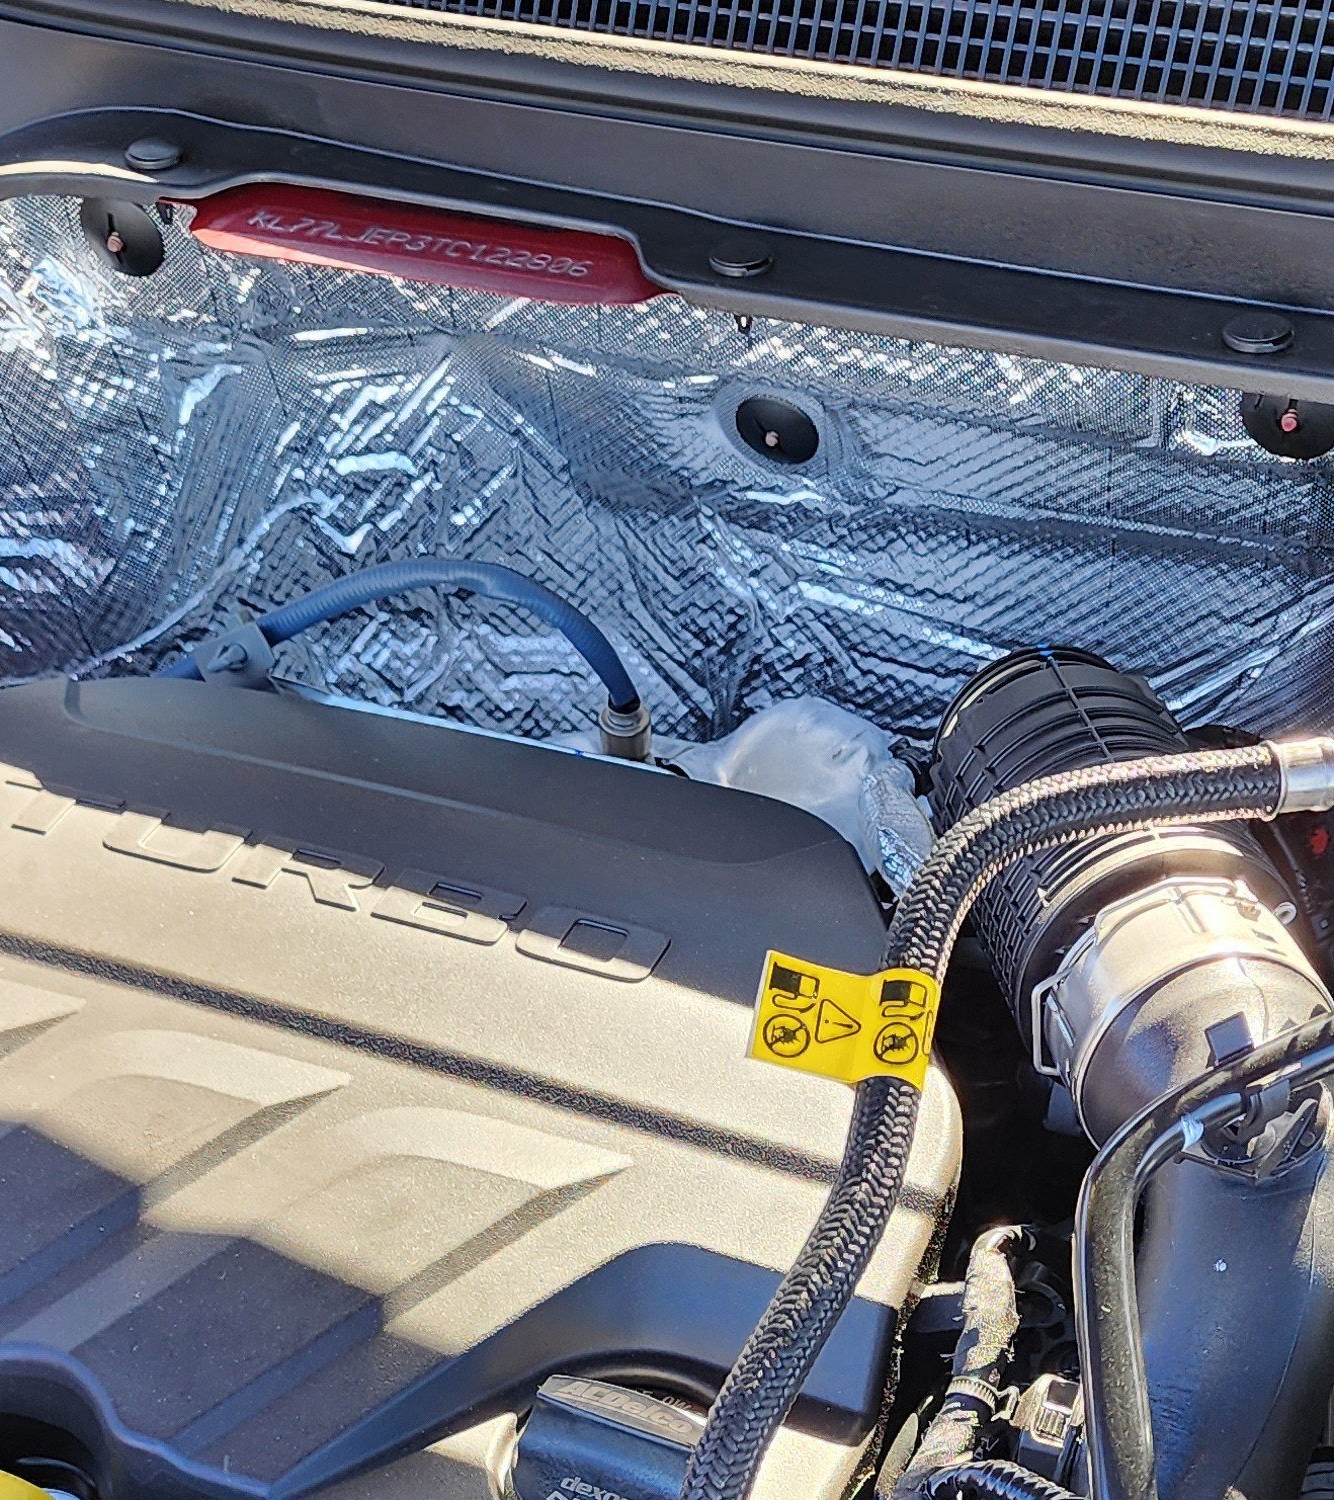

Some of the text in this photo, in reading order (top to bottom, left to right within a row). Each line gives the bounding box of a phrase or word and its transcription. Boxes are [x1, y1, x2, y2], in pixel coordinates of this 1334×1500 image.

[248, 210, 593, 277] KL77LJEP3TC122806
[5, 778, 672, 982] TURBO
[556, 1381, 693, 1433] ACDelco
